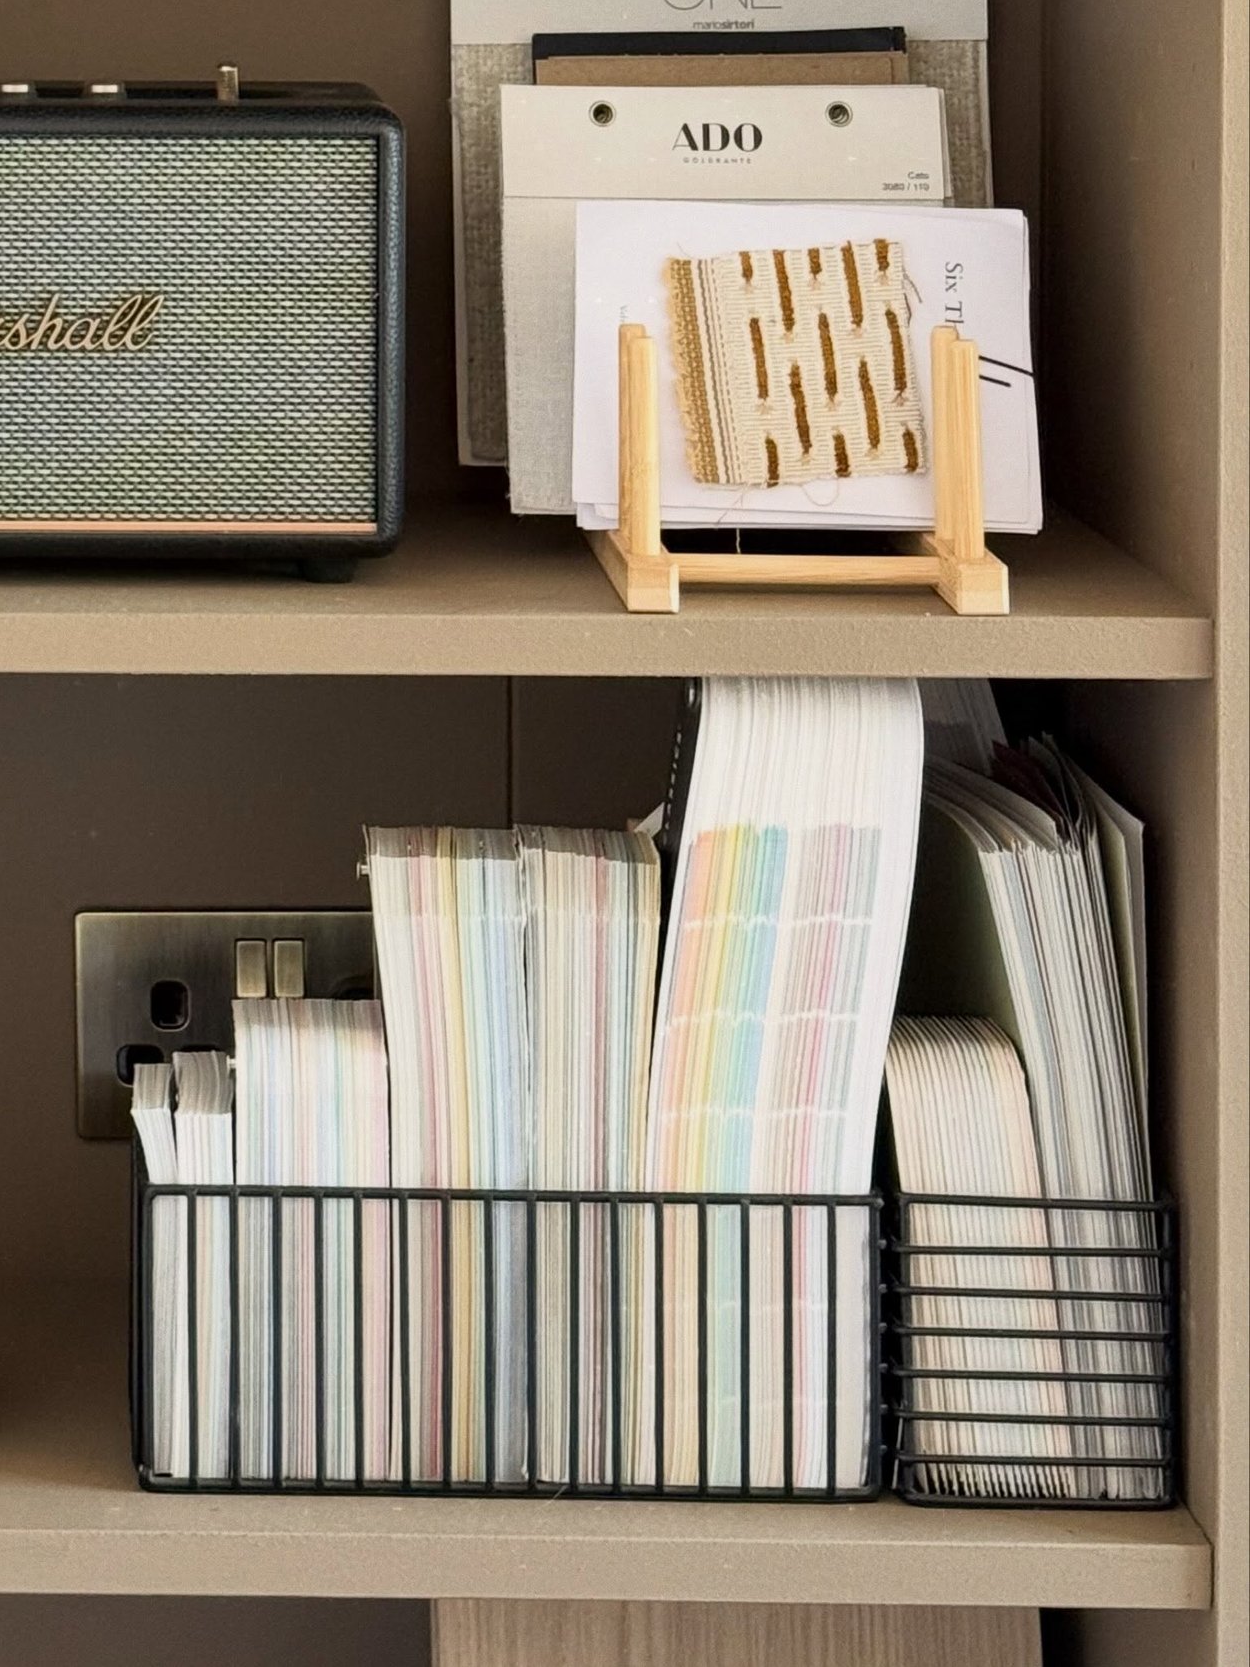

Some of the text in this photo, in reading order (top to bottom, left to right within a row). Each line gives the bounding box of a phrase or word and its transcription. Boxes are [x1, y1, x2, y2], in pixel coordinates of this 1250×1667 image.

[693, 18, 755, 30] mariosirtori
[672, 122, 763, 153] ADO
[944, 261, 964, 293] Six
